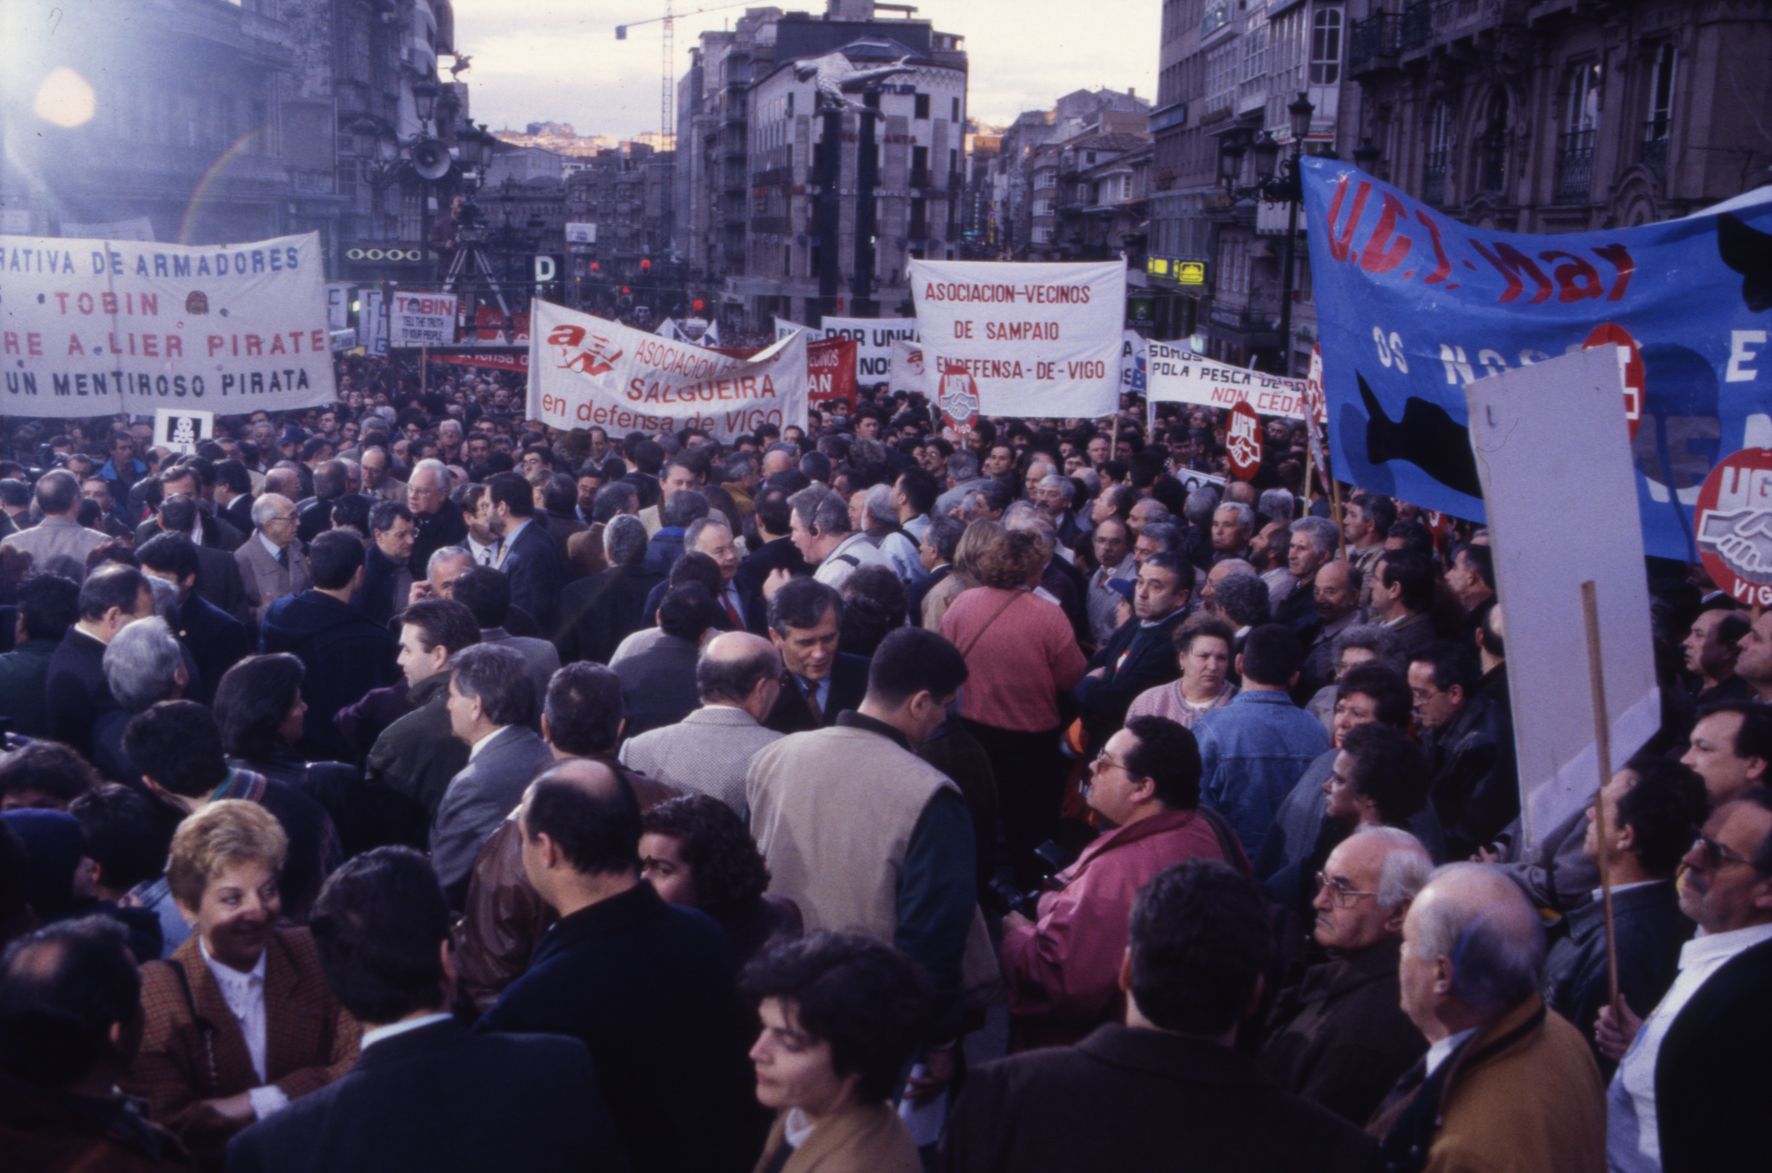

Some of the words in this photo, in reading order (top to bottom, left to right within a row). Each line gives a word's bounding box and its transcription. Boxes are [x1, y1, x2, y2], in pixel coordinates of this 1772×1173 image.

[92, 251, 124, 275] DE
[137, 246, 299, 277] ARMADORES
[55, 291, 158, 316] TOBIN
[68, 333, 85, 356] A
[108, 332, 183, 357] LIER
[207, 329, 325, 357] PIRATE
[954, 320, 974, 339] DE
[986, 321, 1060, 341] SAMPAIO
[634, 338, 717, 380] ASOCIACION
[1373, 326, 1408, 374] OS
[6, 371, 38, 395] UN
[52, 370, 205, 397] MENTIROSO
[222, 368, 309, 396] PIRATA
[1152, 362, 1189, 377] POLA
[1200, 367, 1251, 385] PESCA
[627, 374, 776, 403] SALGUEIRA
[1211, 386, 1249, 403] NON
[542, 393, 566, 416] en
[577, 399, 674, 432] defensa
[685, 411, 715, 433] de
[726, 409, 784, 433] VIGO
